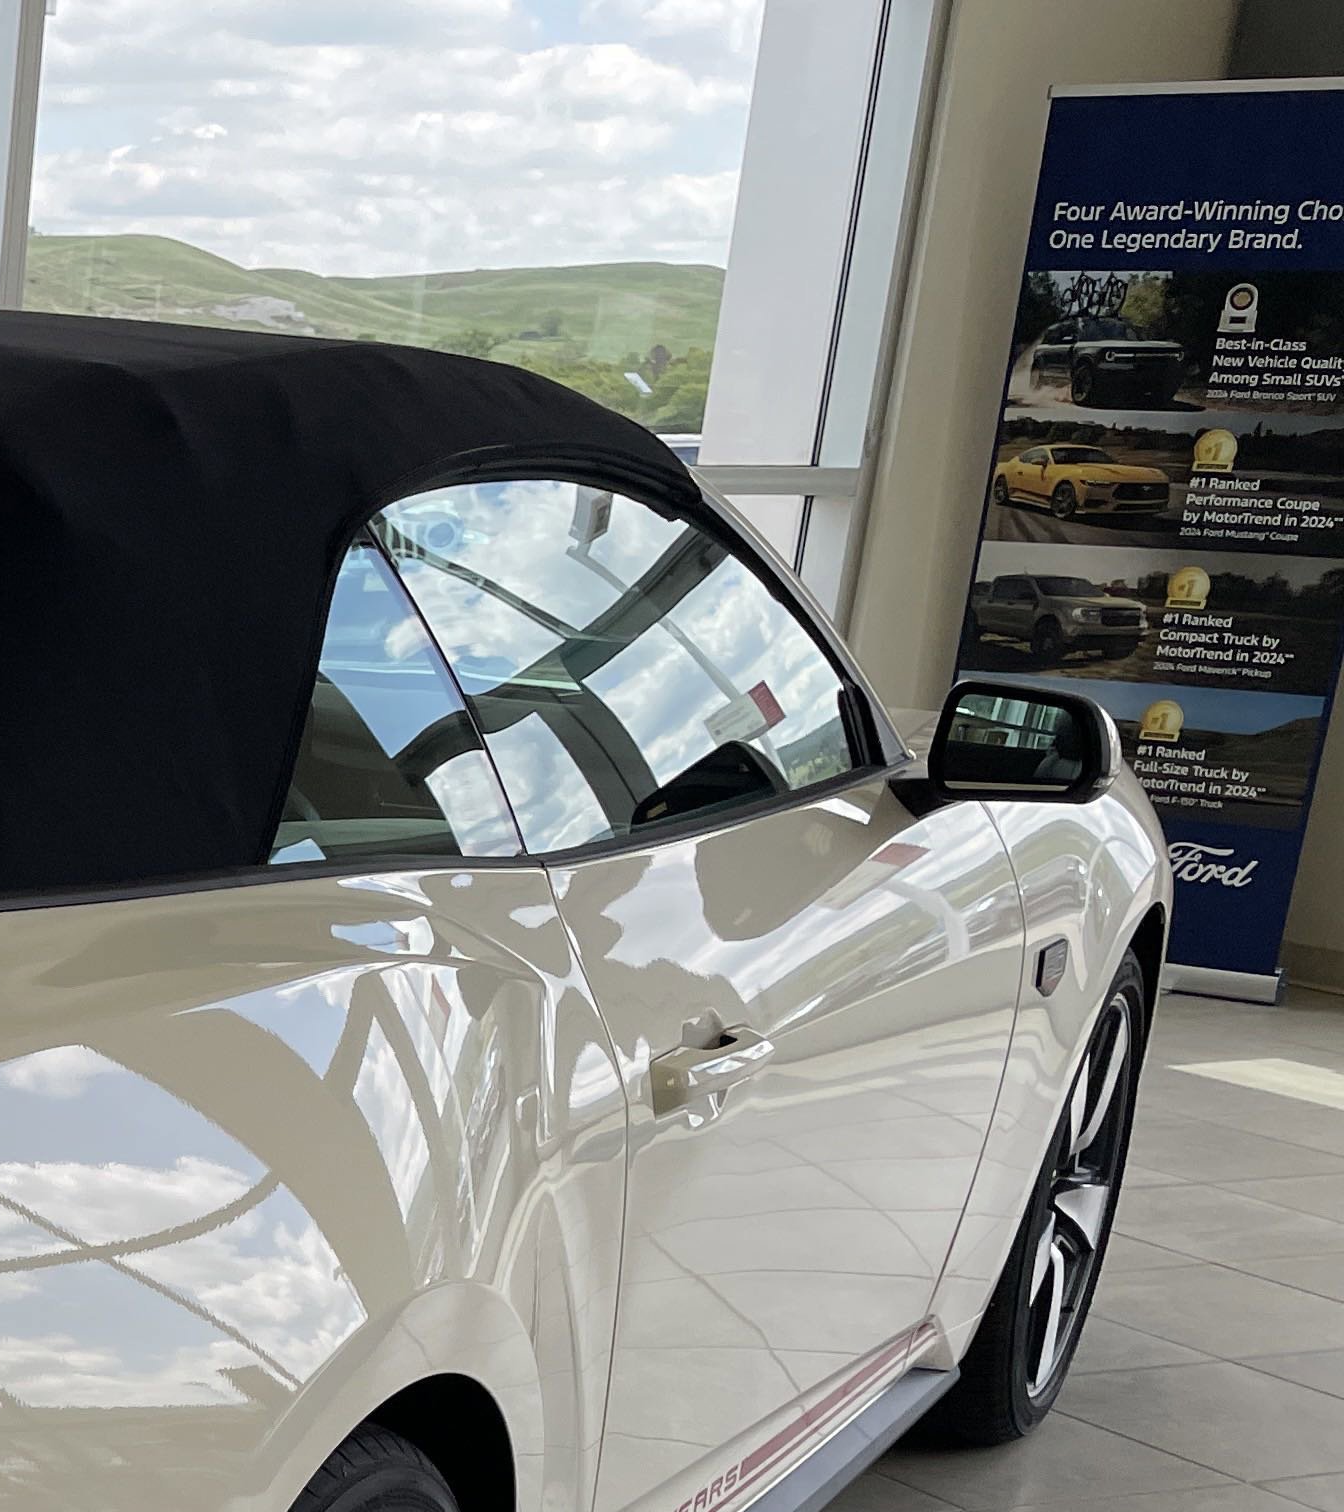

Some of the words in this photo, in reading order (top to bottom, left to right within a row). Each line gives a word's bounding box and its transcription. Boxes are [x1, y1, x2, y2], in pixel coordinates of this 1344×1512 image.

[1053, 202, 1105, 221] Four
[1109, 199, 1290, 224] Award-Winning
[1297, 199, 1344, 221] Cho
[1049, 229, 1094, 249] One
[1101, 228, 1222, 253] Legendary
[1227, 228, 1303, 250] Brand.
[1215, 337, 1307, 351] Best-in-Class
[1212, 354, 1245, 367] New
[1247, 355, 1297, 368] Vehicle
[1300, 356, 1344, 371] Qualit
[1208, 371, 1259, 387] Among
[1261, 373, 1302, 386] Small
[1189, 476, 1206, 489] #1
[1209, 477, 1261, 491] Ranked
[1185, 493, 1273, 509] Performance
[1276, 497, 1321, 513] Coupe
[1182, 509, 1201, 524] by
[1203, 510, 1281, 526] MotorTrend
[1284, 515, 1297, 527] in
[1162, 612, 1179, 625] #1
[1182, 612, 1233, 628] Ranked
[1159, 628, 1219, 645] Compact
[1222, 632, 1260, 647] Truck
[1262, 635, 1281, 650] by
[1156, 645, 1234, 662] MotorTrend
[1235, 649, 1249, 663] in
[1136, 744, 1153, 756] #1
[1155, 745, 1206, 761] Ranked
[1133, 759, 1189, 777] Full-Size
[1192, 765, 1229, 780] Truck
[1231, 768, 1250, 783] by
[1208, 781, 1222, 795] in
[1167, 841, 1259, 888] Ford
